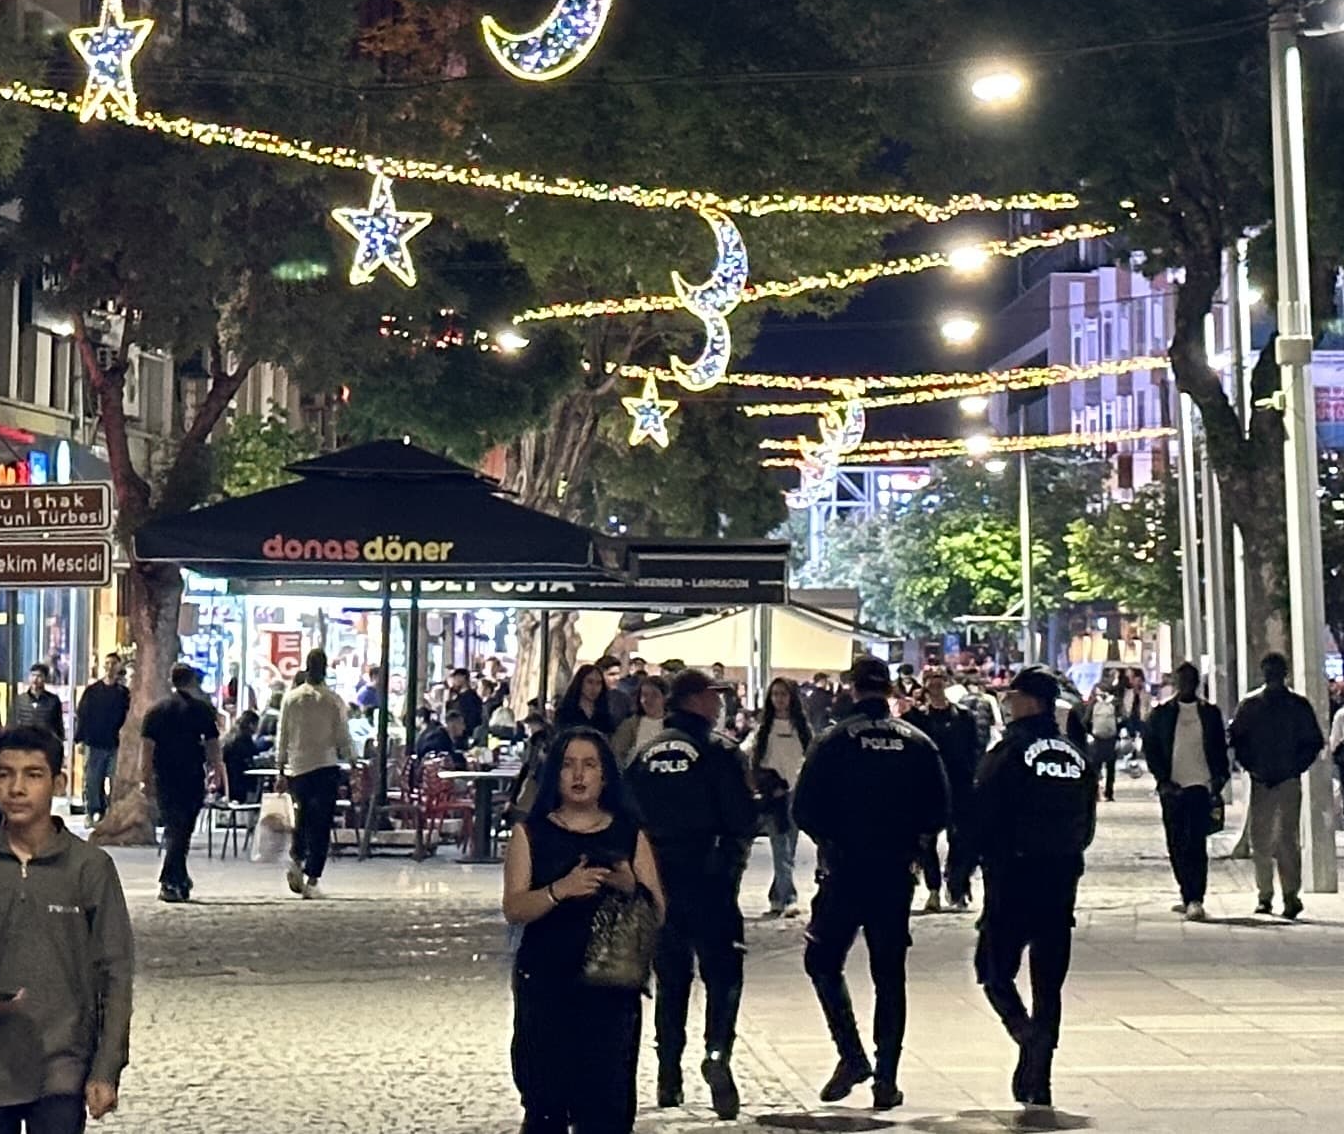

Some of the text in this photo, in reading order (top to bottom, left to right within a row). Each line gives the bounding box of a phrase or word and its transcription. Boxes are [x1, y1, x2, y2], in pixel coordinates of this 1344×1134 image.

[262, 534, 454, 561] donas döner
[42, 553, 102, 573] Mescidi
